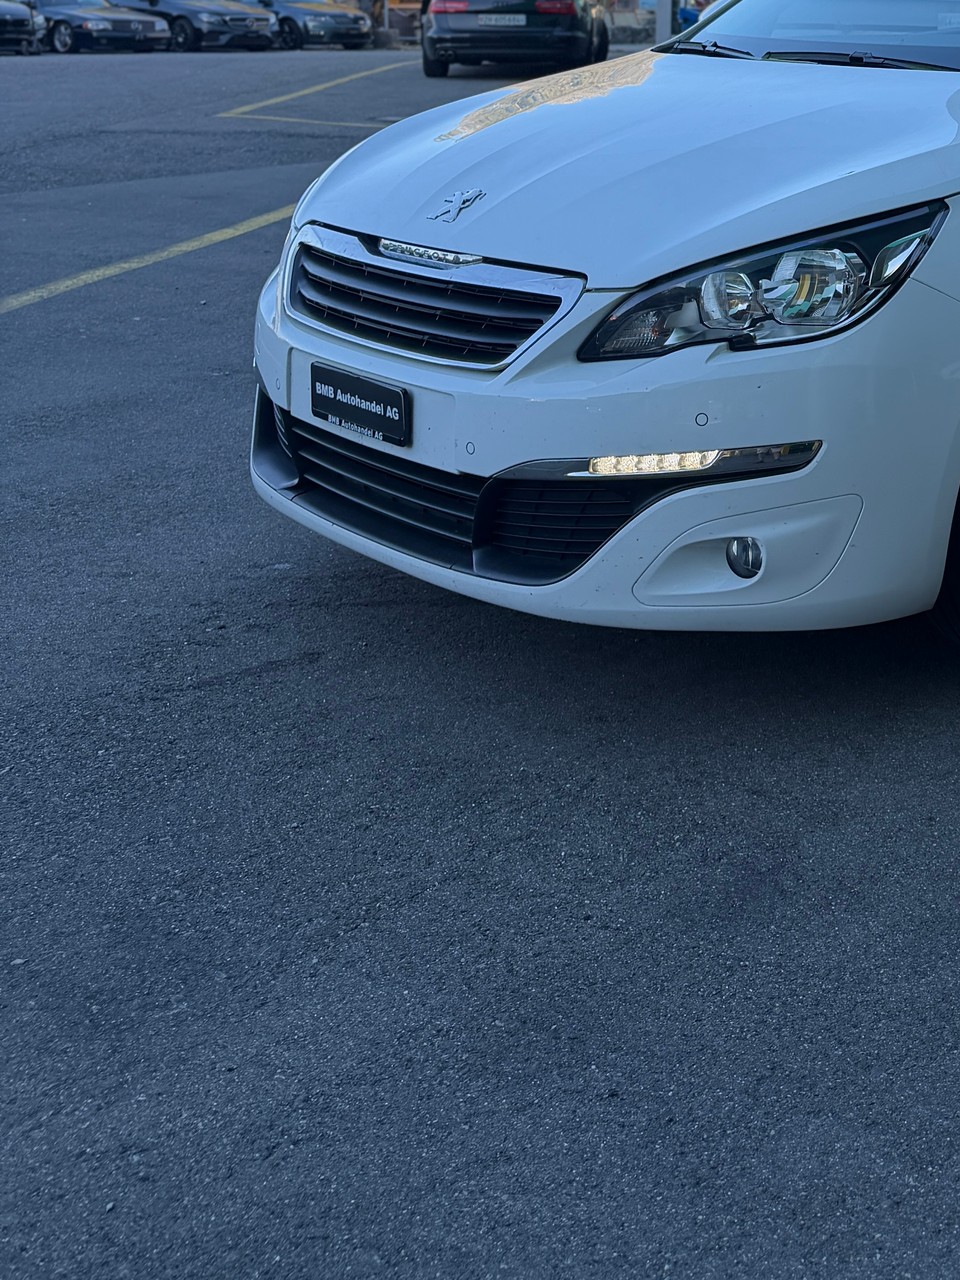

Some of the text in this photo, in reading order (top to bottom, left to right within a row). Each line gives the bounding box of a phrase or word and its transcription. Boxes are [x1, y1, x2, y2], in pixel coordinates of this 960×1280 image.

[387, 242, 448, 263] PEUGEOT
[315, 381, 400, 421] BMB Autohandel AG
[327, 414, 384, 441] BMB Autohandel AG
